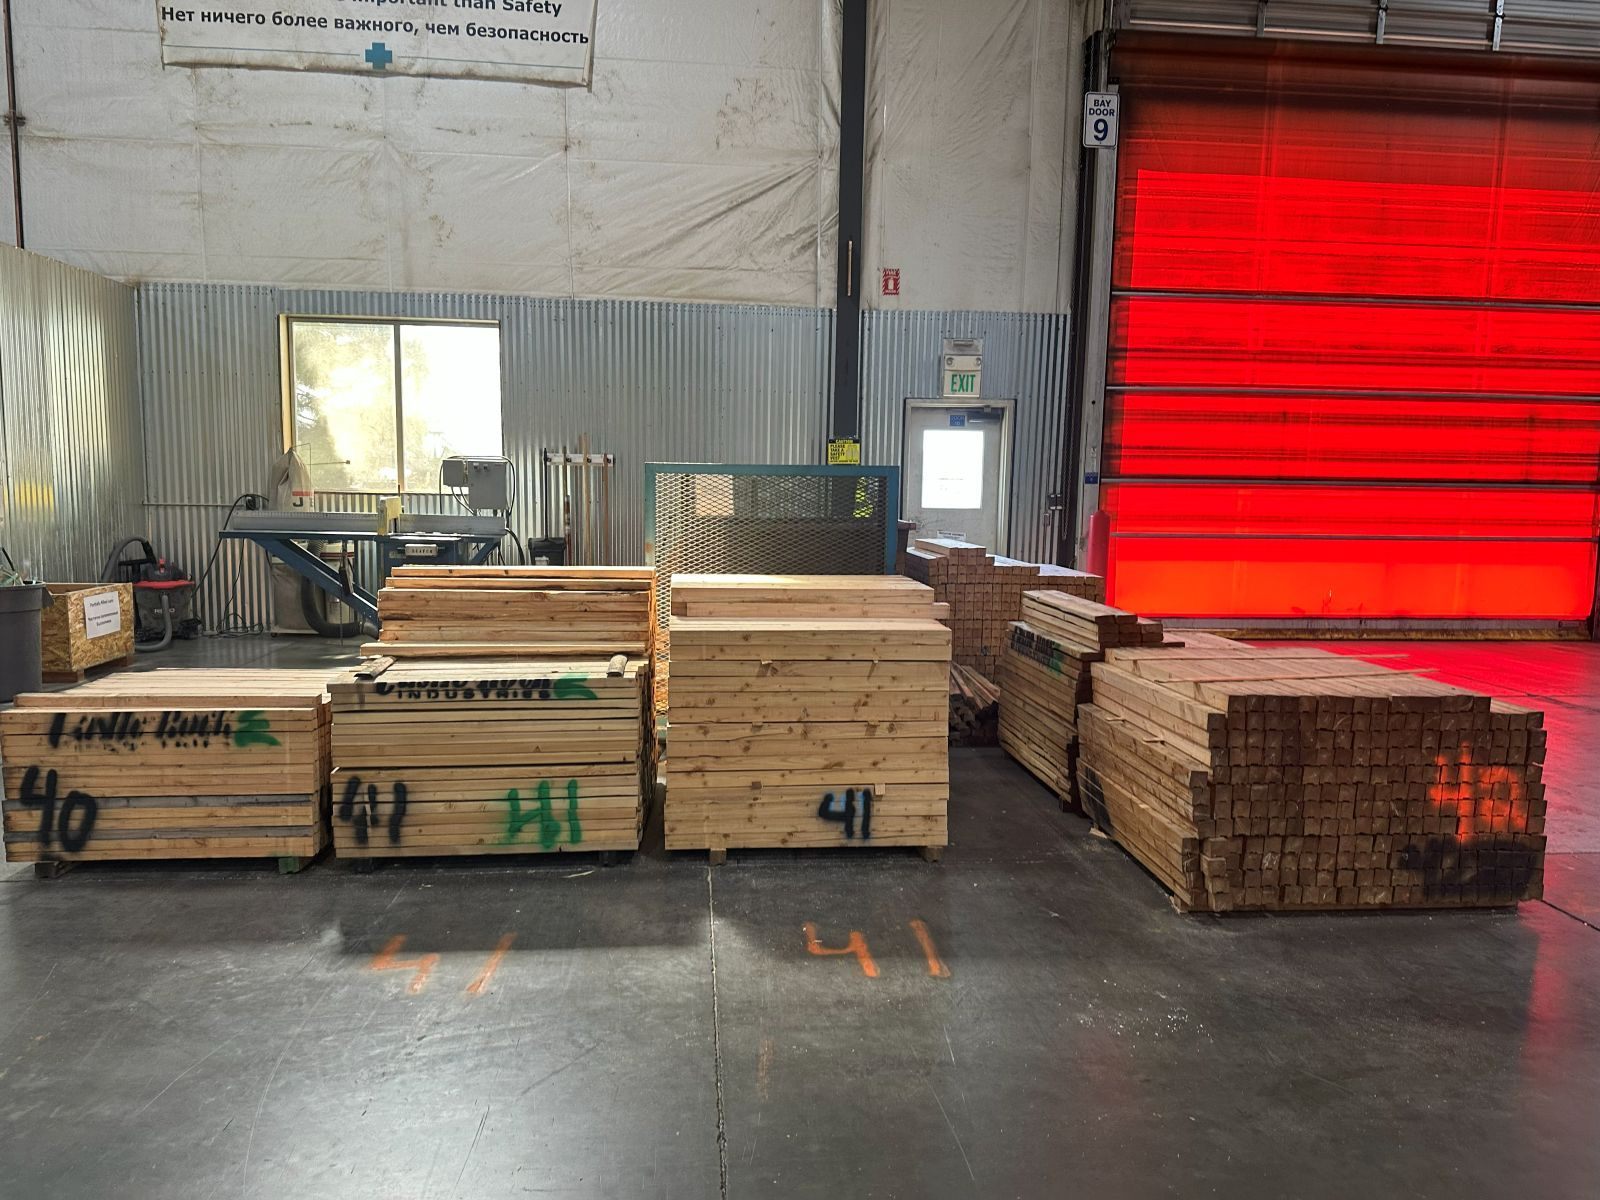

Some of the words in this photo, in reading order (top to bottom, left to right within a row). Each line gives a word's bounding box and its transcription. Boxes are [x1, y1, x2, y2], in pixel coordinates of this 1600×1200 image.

[454, 0, 495, 9] than
[503, 0, 562, 17] Safety
[161, 6, 195, 21] Нет
[201, 11, 266, 25] ничего
[272, 11, 328, 28] более
[334, 17, 419, 36] важного,
[426, 22, 460, 35] чем
[466, 22, 589, 44] безопасность
[1089, 108, 1115, 116] DOOR
[1094, 99, 1111, 107] BAY
[1094, 118, 1108, 141] 9
[951, 374, 976, 392] EXIT
[398, 688, 550, 699] INDUSTRIES
[20, 765, 98, 853] 40
[818, 788, 870, 839] 41
